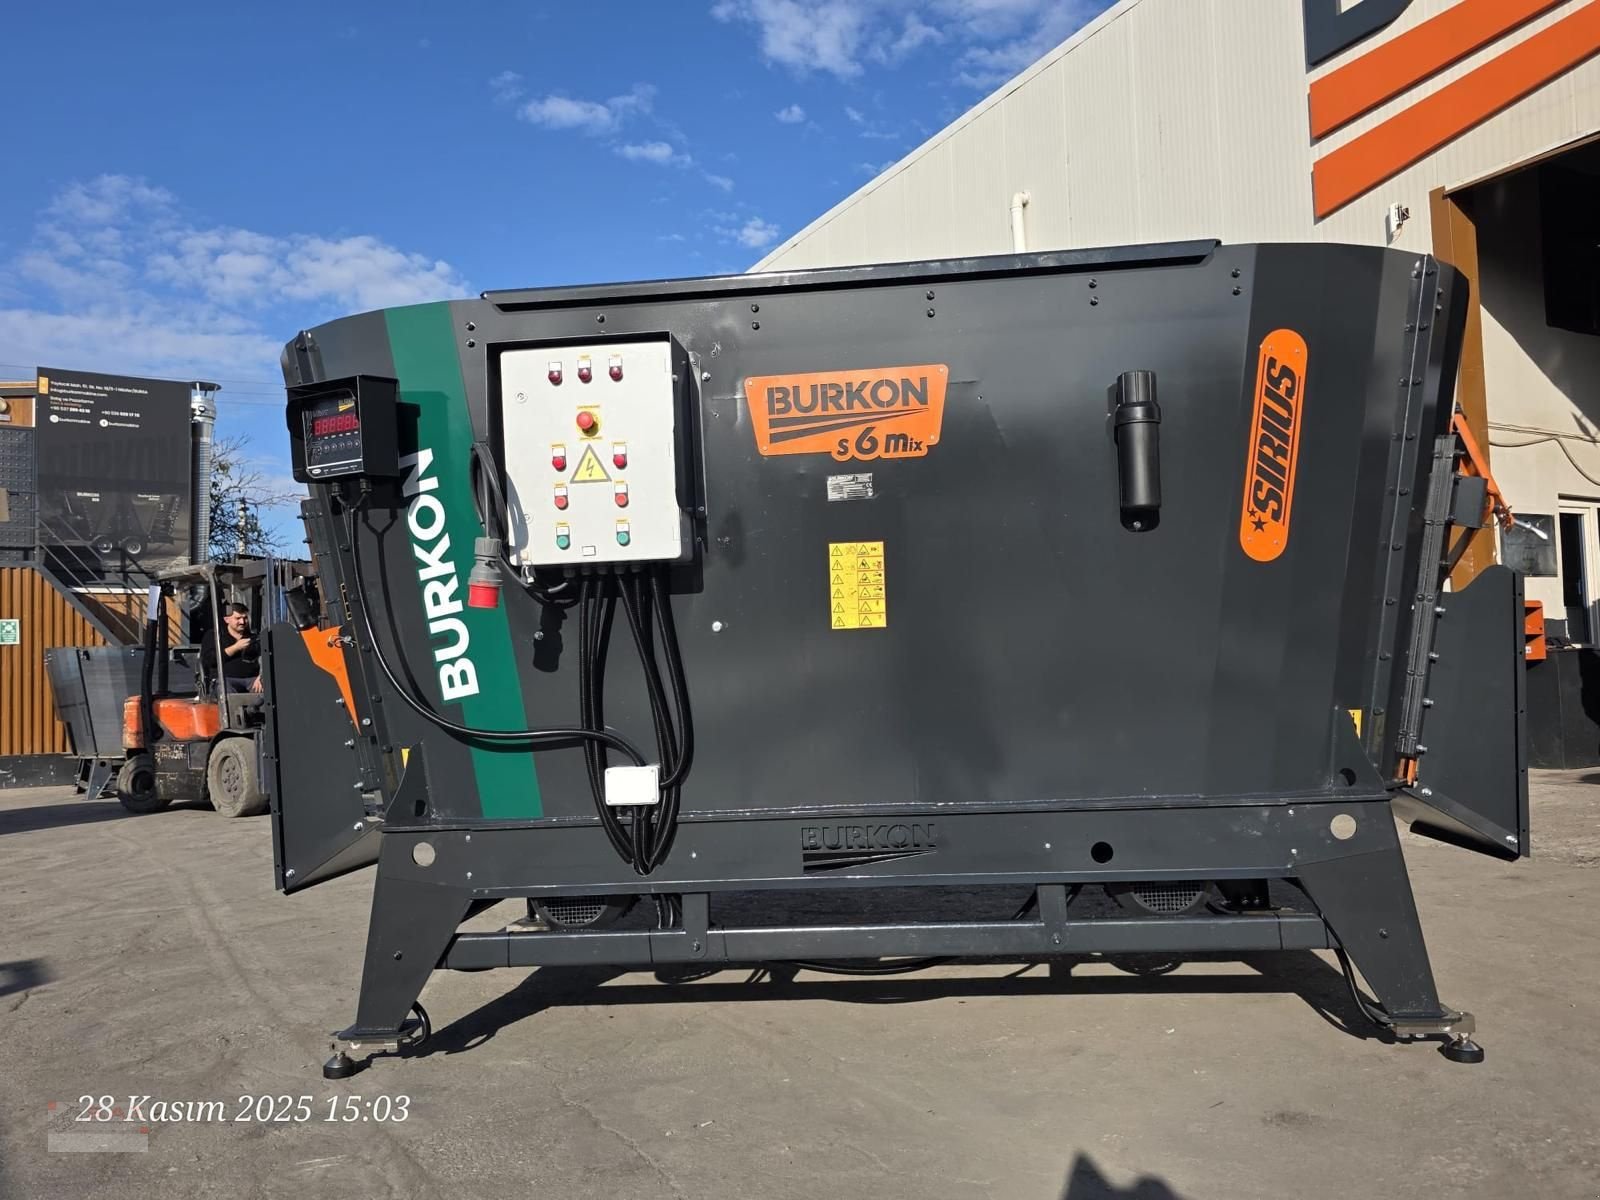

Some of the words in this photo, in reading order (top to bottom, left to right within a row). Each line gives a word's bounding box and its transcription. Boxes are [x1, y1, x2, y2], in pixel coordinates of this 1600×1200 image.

[766, 376, 929, 416] BURKON
[1252, 356, 1297, 523] SIRIUS
[398, 448, 480, 702] BURKON
[801, 823, 937, 850] BURKON
